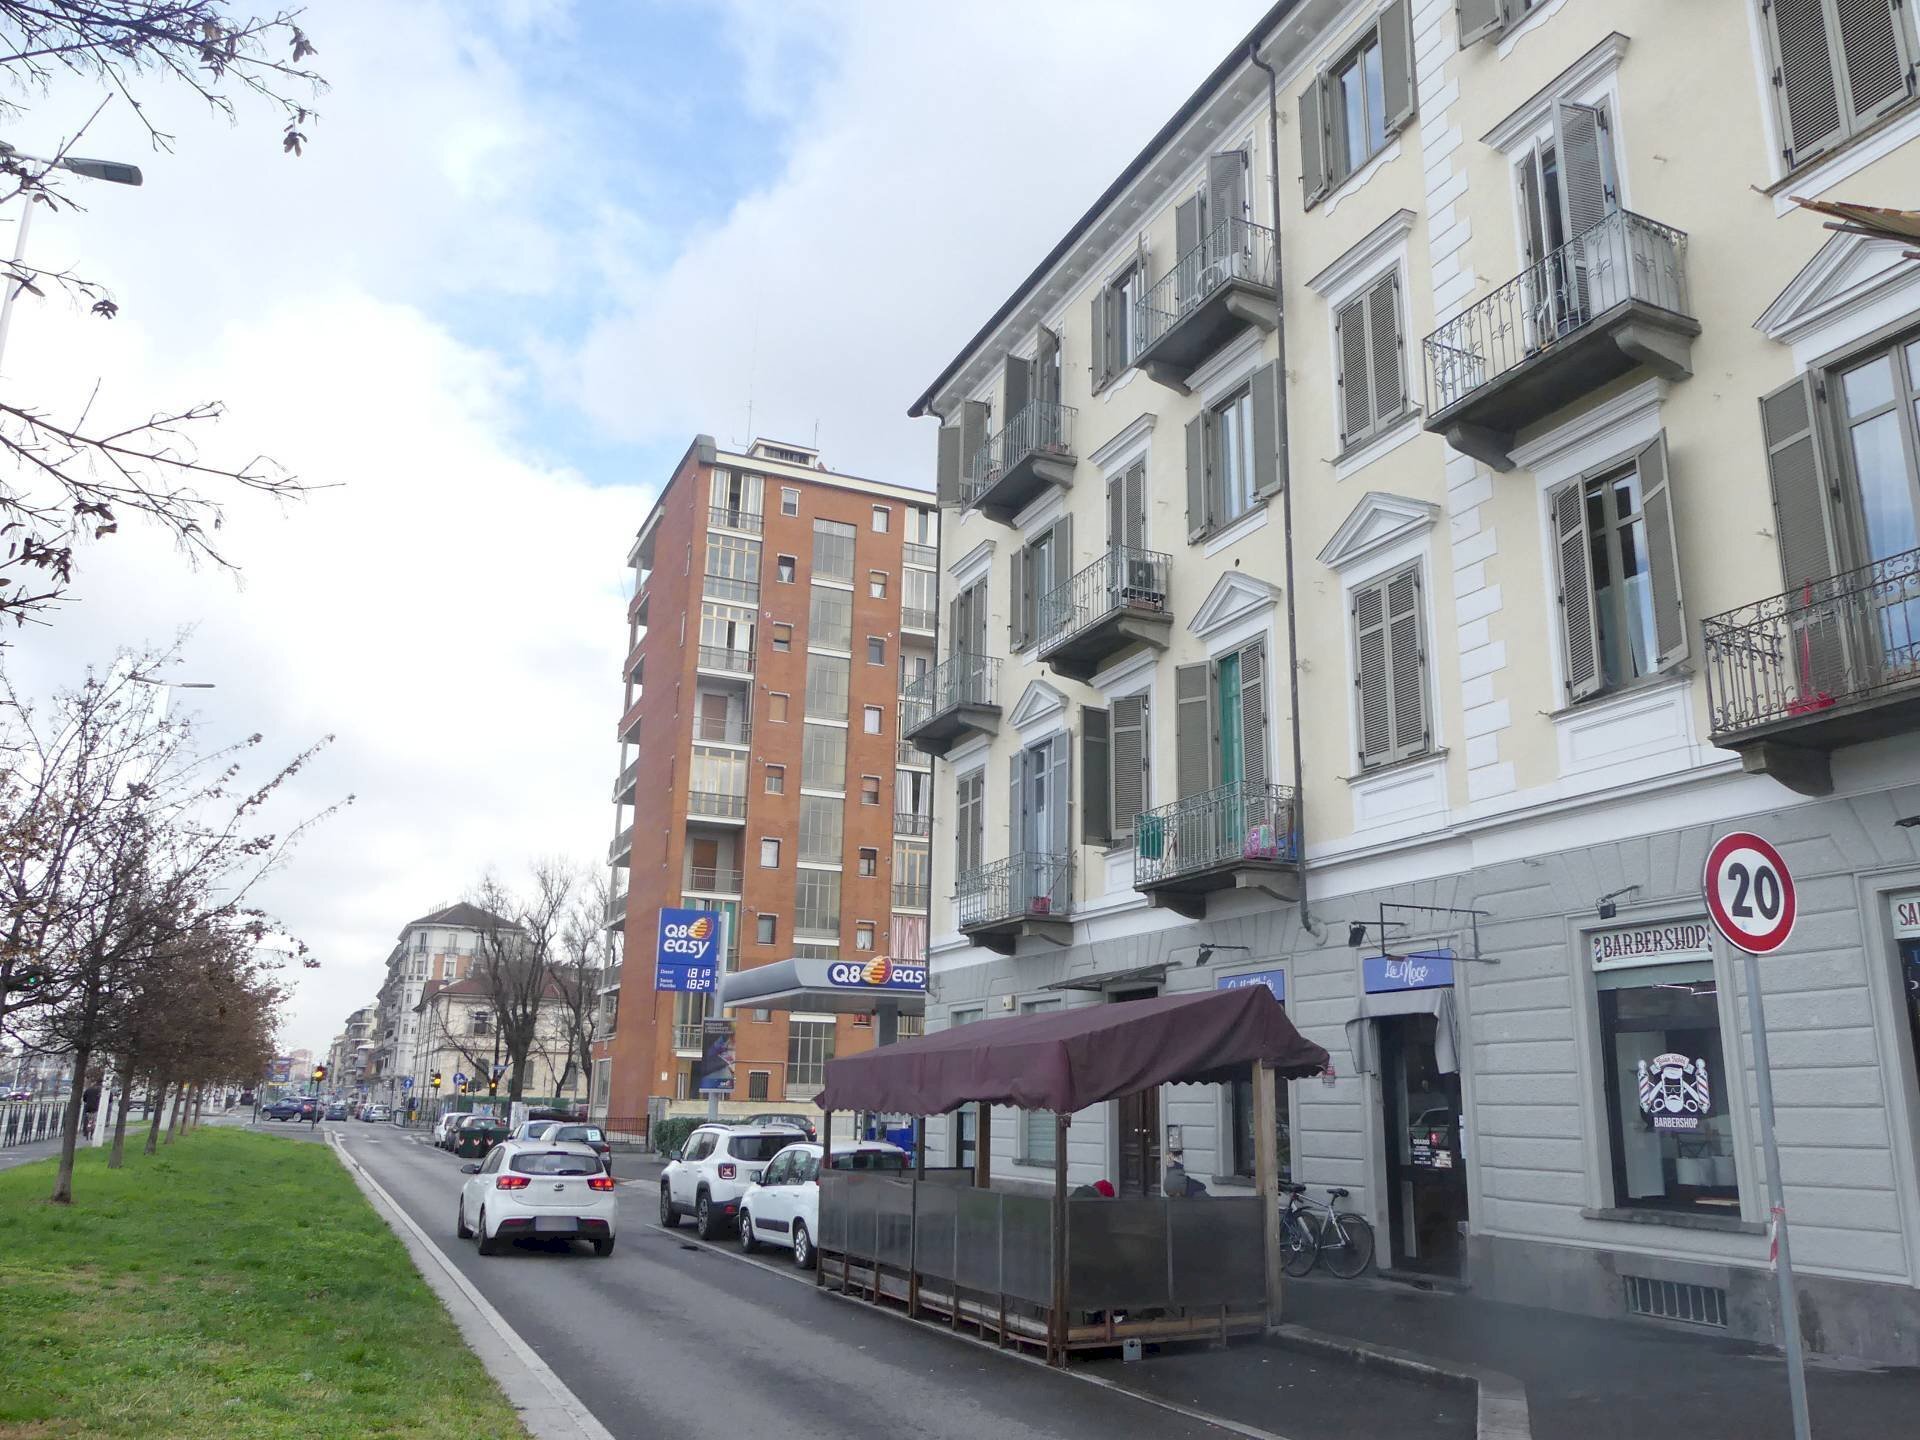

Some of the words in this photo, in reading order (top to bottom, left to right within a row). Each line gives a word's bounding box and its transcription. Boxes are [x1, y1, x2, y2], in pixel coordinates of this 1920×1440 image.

[1728, 862, 1780, 920] 20
[665, 924, 687, 938] Q8
[664, 939, 710, 959] easy
[1603, 924, 1706, 958] BARBERSHOP
[832, 964, 861, 983] Q8
[1385, 960, 1401, 978] La
[1653, 1116, 1698, 1129] BARBERSHOP
